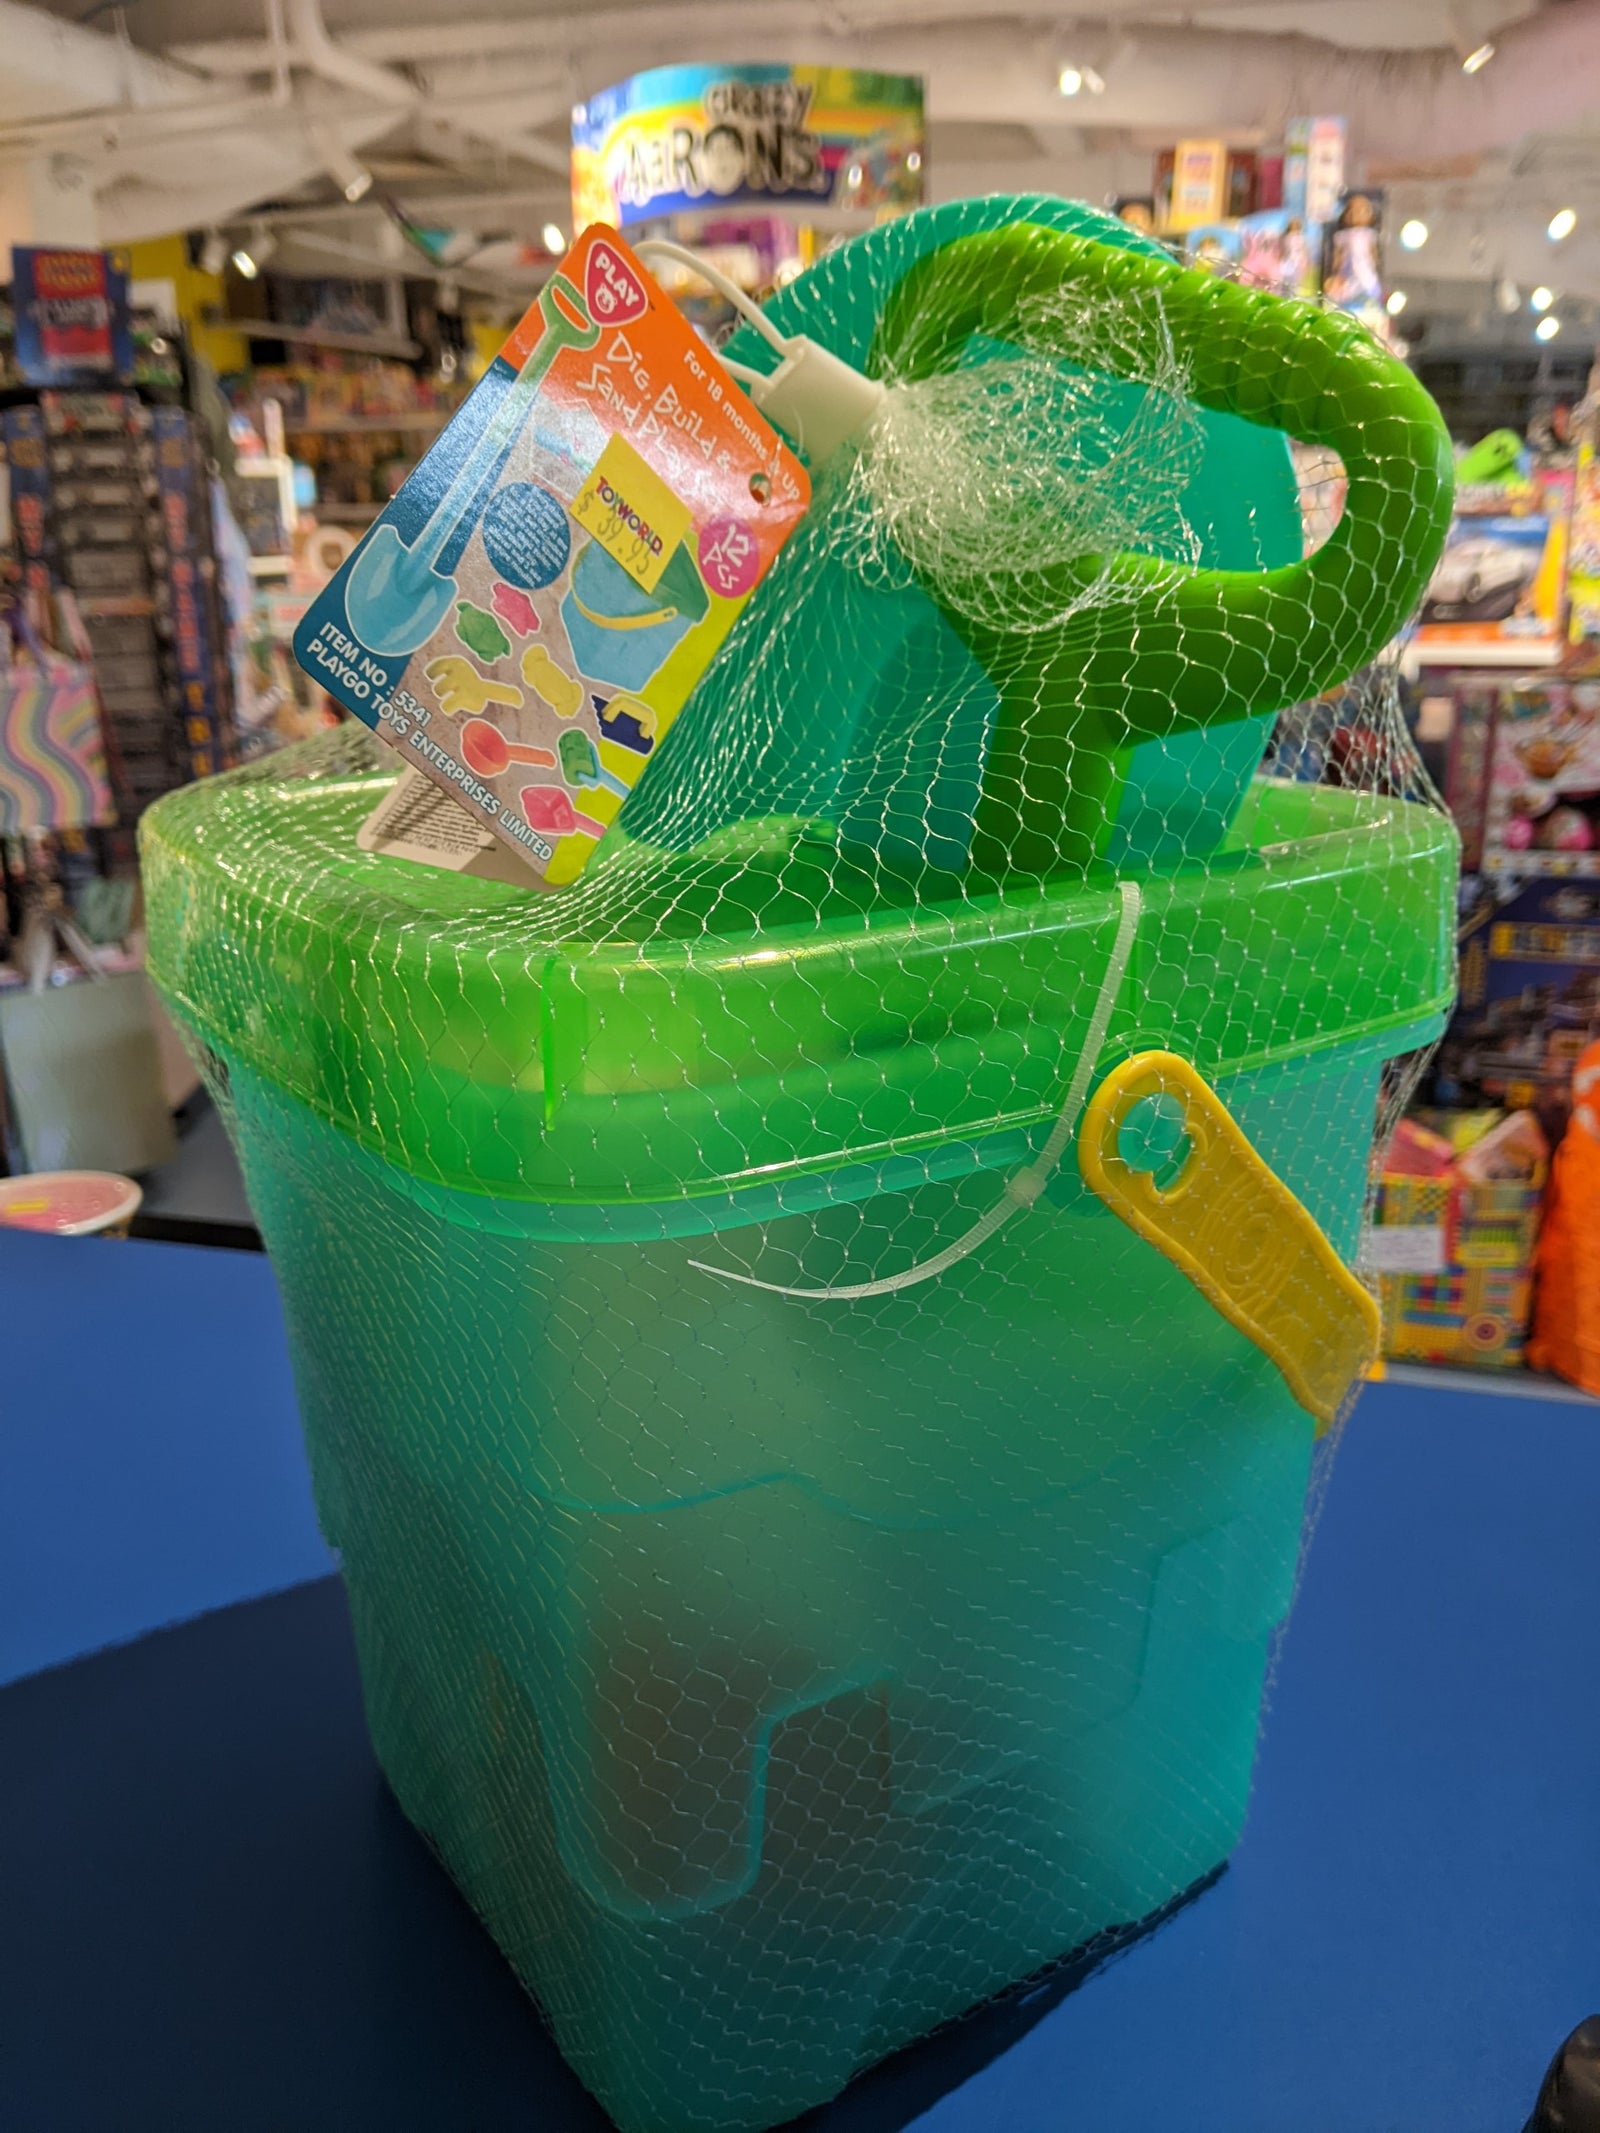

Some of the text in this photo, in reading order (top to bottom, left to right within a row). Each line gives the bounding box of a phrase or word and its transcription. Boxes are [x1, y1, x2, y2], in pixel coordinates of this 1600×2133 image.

[594, 251, 640, 307] PLAY
[683, 349, 707, 381] For
[707, 377, 723, 402] 18
[722, 401, 768, 461] months
[782, 472, 801, 501] Up
[716, 450, 731, 473] &
[595, 475, 664, 557] TOYWORLD
[721, 523, 750, 568] 12
[320, 621, 360, 663] ITEM
[358, 657, 388, 687] NO
[394, 690, 432, 727] 5341
[306, 638, 370, 699] PLAYGO
[370, 692, 411, 735] TOYS
[409, 729, 502, 815] ENTERPRISES
[499, 808, 553, 862] LIMITED
